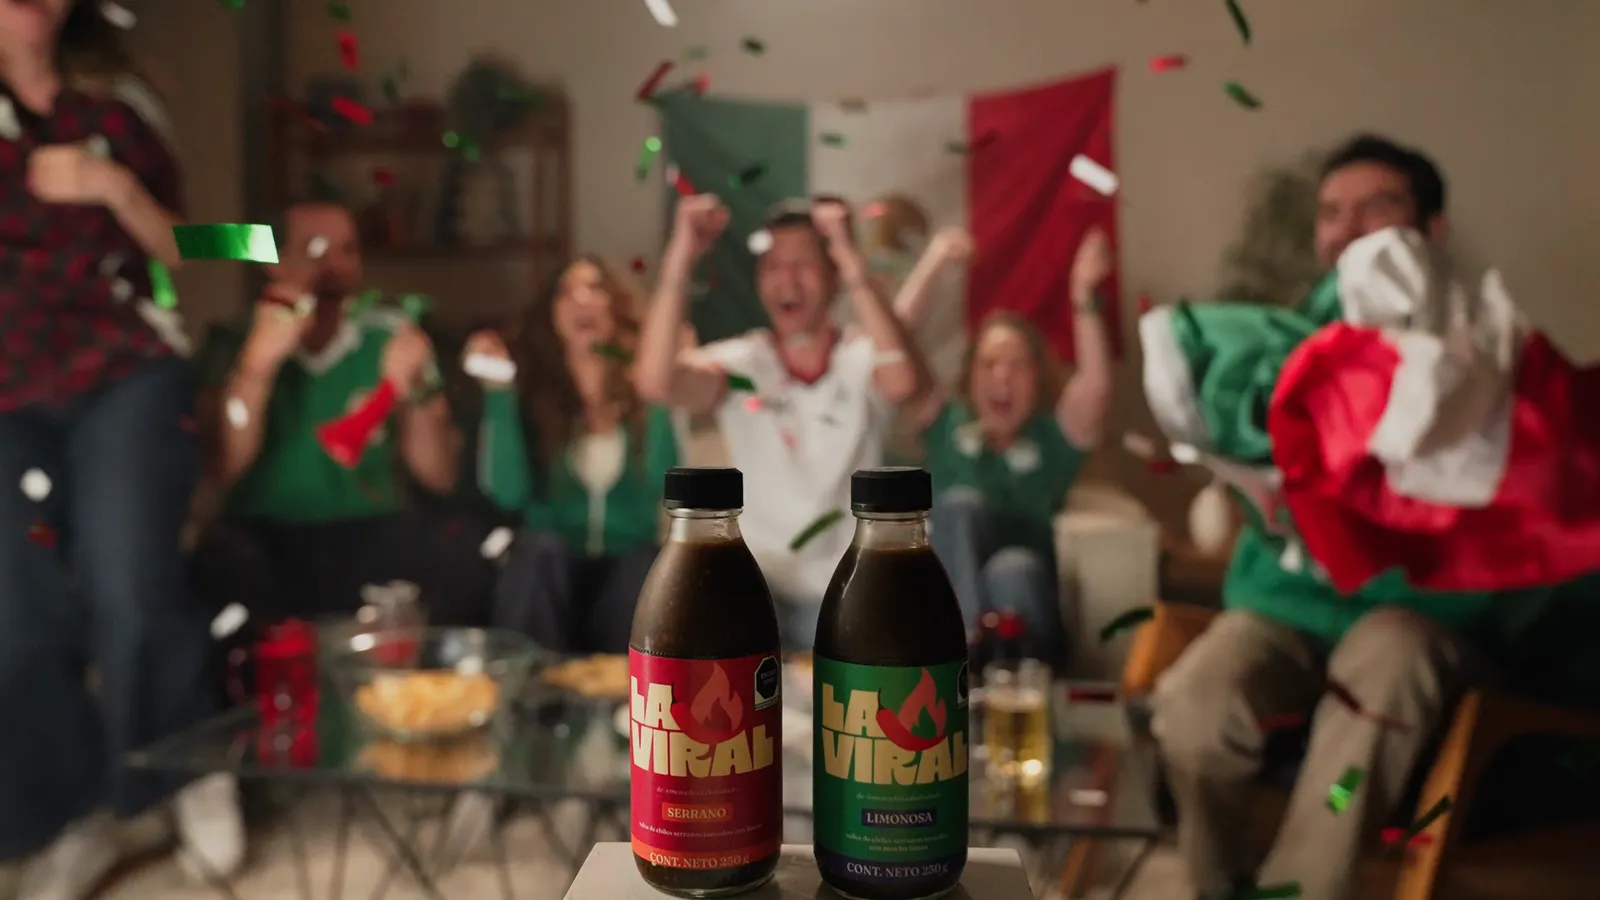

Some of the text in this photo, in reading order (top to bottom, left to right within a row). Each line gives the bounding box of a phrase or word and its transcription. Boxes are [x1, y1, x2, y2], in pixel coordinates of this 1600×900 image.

[631, 675, 681, 731] LA
[822, 682, 889, 739] LA
[631, 724, 774, 778] VIRAL
[822, 730, 968, 785] VIRAL
[667, 807, 727, 819] SERRANO
[867, 812, 933, 825] LIMONOSA
[650, 852, 750, 868] CONT. NETO 250 g
[846, 862, 882, 877] CONT.
[885, 867, 920, 878] NETO
[921, 863, 942, 875] 250
